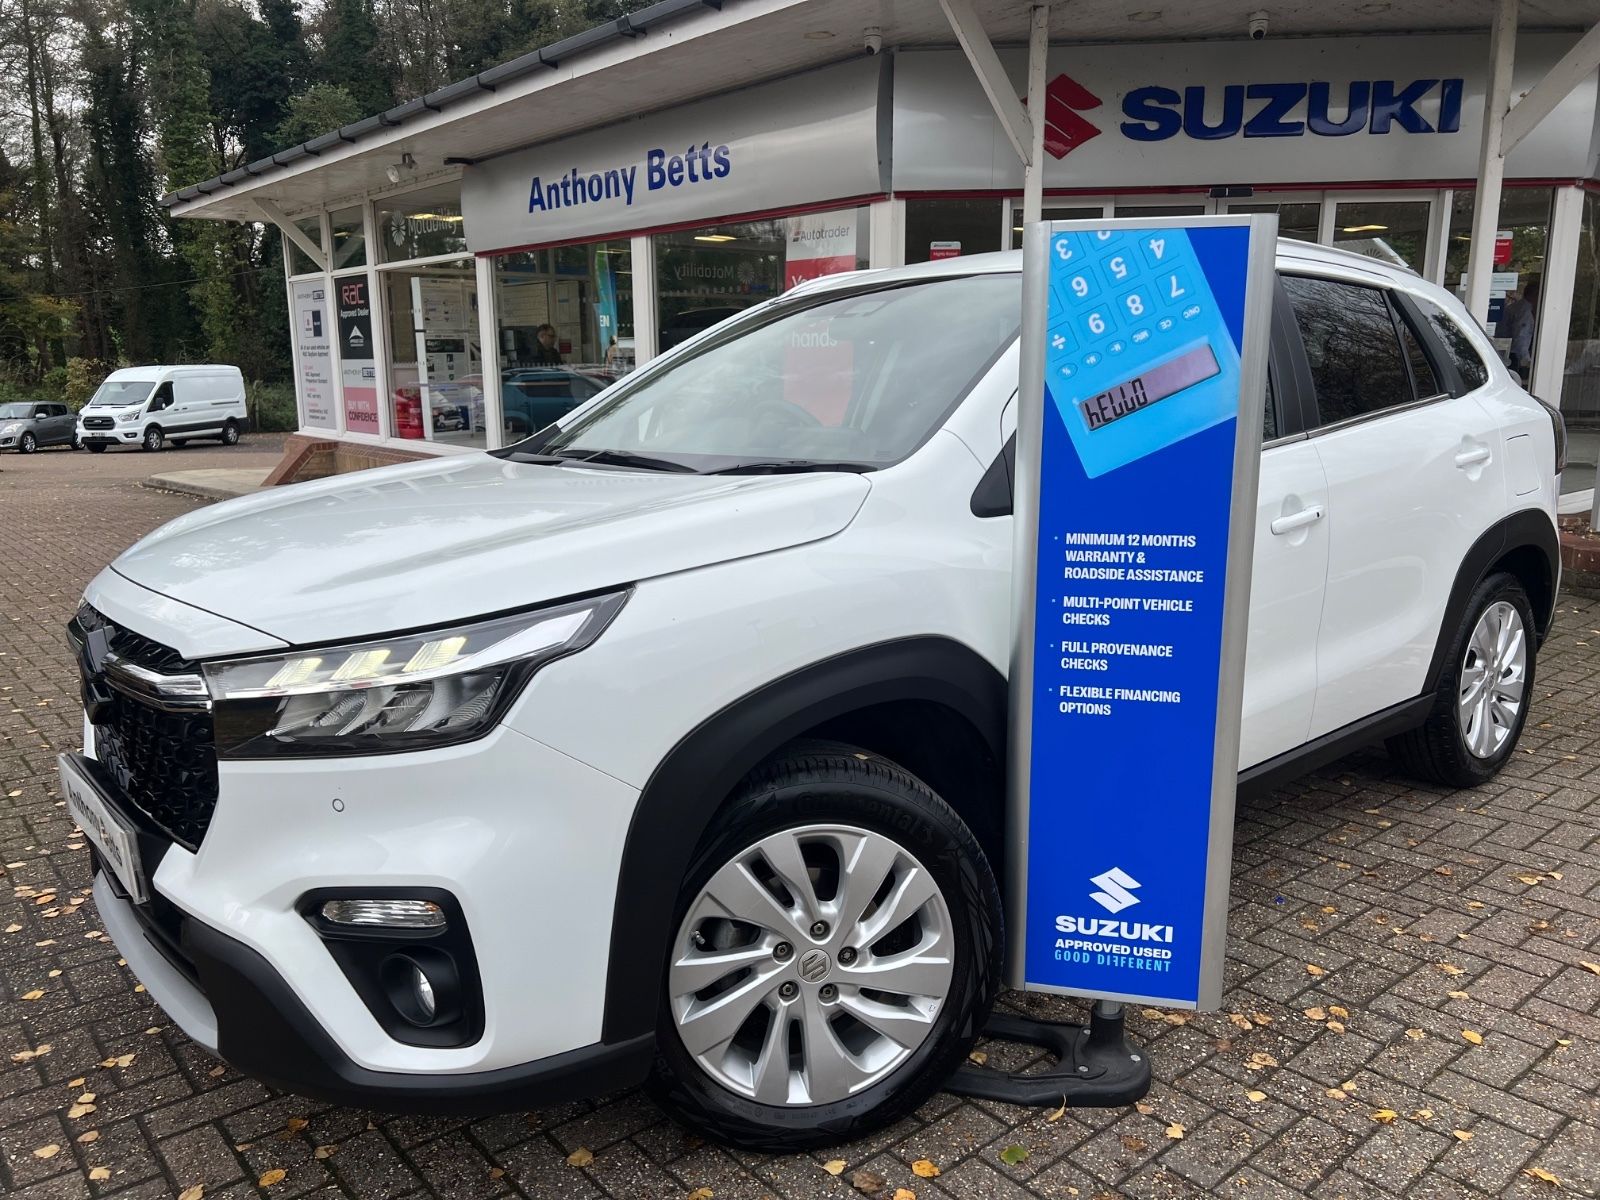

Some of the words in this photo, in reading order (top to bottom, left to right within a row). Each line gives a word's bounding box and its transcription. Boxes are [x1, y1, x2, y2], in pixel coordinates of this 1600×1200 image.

[1120, 79, 1464, 141] SUZUKI
[528, 166, 637, 213] Anthony
[647, 141, 731, 191] Betts
[800, 226, 850, 241] Autotrader
[1056, 239, 1072, 260] 3
[1149, 239, 1165, 259] 4
[1110, 257, 1127, 279] 5
[342, 284, 365, 305] RAC
[1170, 275, 1185, 298] 7
[1126, 295, 1144, 315] 8
[792, 327, 838, 348] hands
[348, 411, 378, 422] CONFIDENCE
[1065, 533, 1125, 546] MINIMUM
[1126, 534, 1140, 546] 12
[1141, 535, 1196, 547] MONTHS
[1065, 550, 1135, 563] WARRANTY
[1136, 552, 1146, 563] &
[1064, 567, 1125, 580] ROADSIDE
[1126, 569, 1204, 582] ASSISTANCE
[1063, 596, 1141, 610] MULTI-POINT
[1142, 598, 1193, 612] VEHICLE
[1062, 612, 1110, 625] CHECKS
[1061, 641, 1090, 653] FULL
[1091, 642, 1173, 657] PROVENANCE
[1061, 657, 1108, 671] CHECKS
[1059, 686, 1113, 699] FLEXIBLE
[1114, 688, 1181, 703] FINANCING
[1059, 702, 1111, 715] OPTIONS
[1055, 915, 1174, 943] SUZUKI
[1055, 938, 1131, 955] APPROVED
[1133, 947, 1172, 959] USED
[1054, 949, 1090, 964] GOOD
[1097, 954, 1171, 972] DIFFERENT
